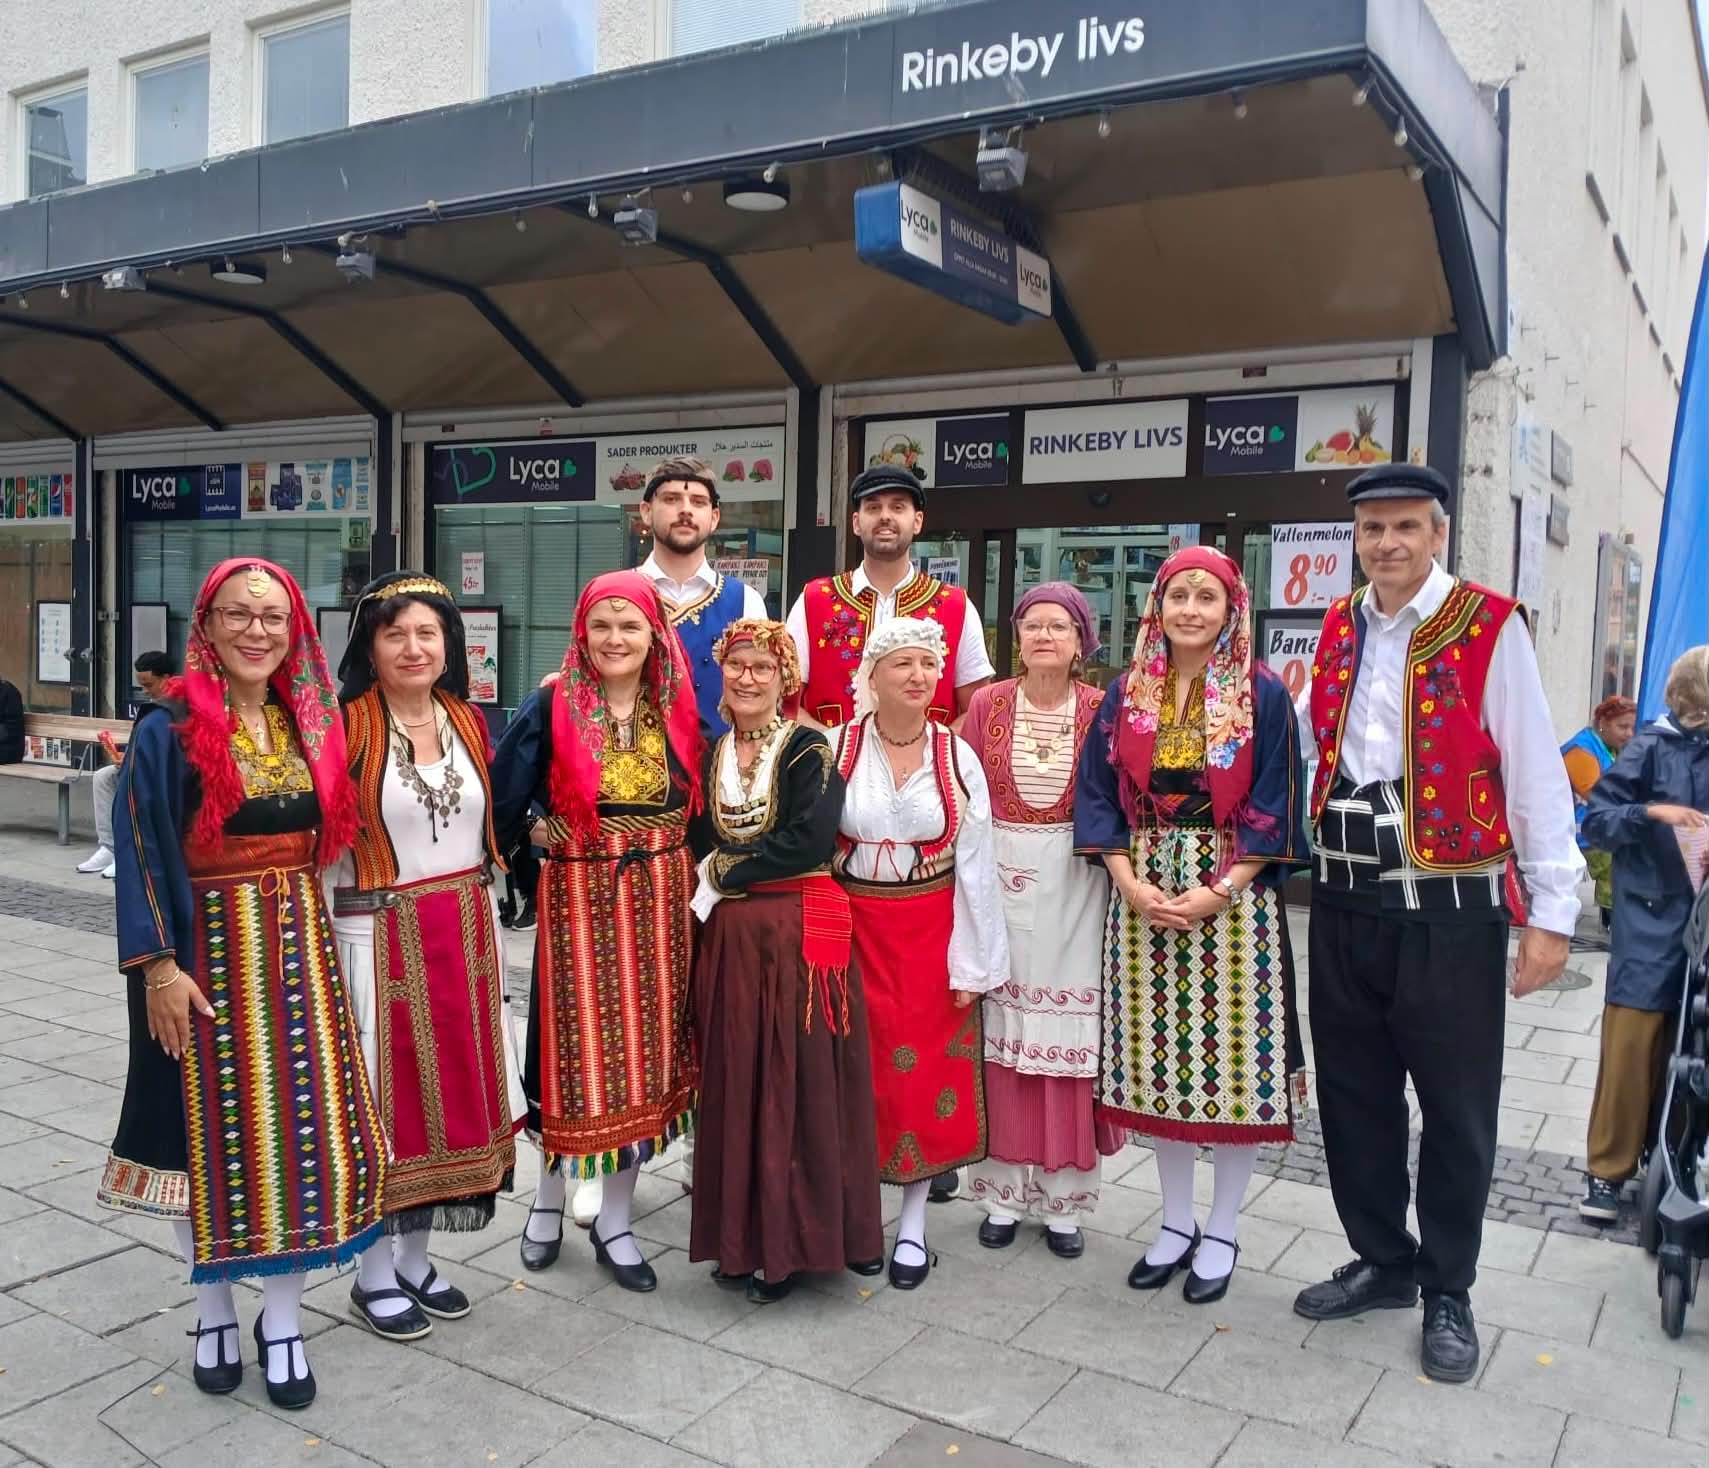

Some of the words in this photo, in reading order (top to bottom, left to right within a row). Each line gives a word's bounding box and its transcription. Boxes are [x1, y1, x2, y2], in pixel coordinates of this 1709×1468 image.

[902, 32, 1064, 92] Rinkeby
[1078, 16, 1145, 61] livs
[901, 200, 929, 232] Lyca
[951, 218, 990, 254] RINKEBY
[991, 240, 1009, 264] LIVS
[1020, 264, 1042, 289] Lyca
[1030, 430, 1128, 455] RINKEBY
[1134, 426, 1183, 449] LIVS
[1205, 424, 1265, 450] Lyca
[607, 447, 637, 458] SADER
[640, 443, 697, 456] PRODUKTER
[943, 440, 993, 464] Lyca
[1230, 446, 1264, 456] Mobile
[510, 456, 560, 485] Lyca
[964, 461, 992, 472] Mobile
[132, 473, 176, 503] Lyca
[531, 481, 560, 492] Mobile
[152, 501, 176, 511] Mobile
[1284, 554, 1310, 605] 8
